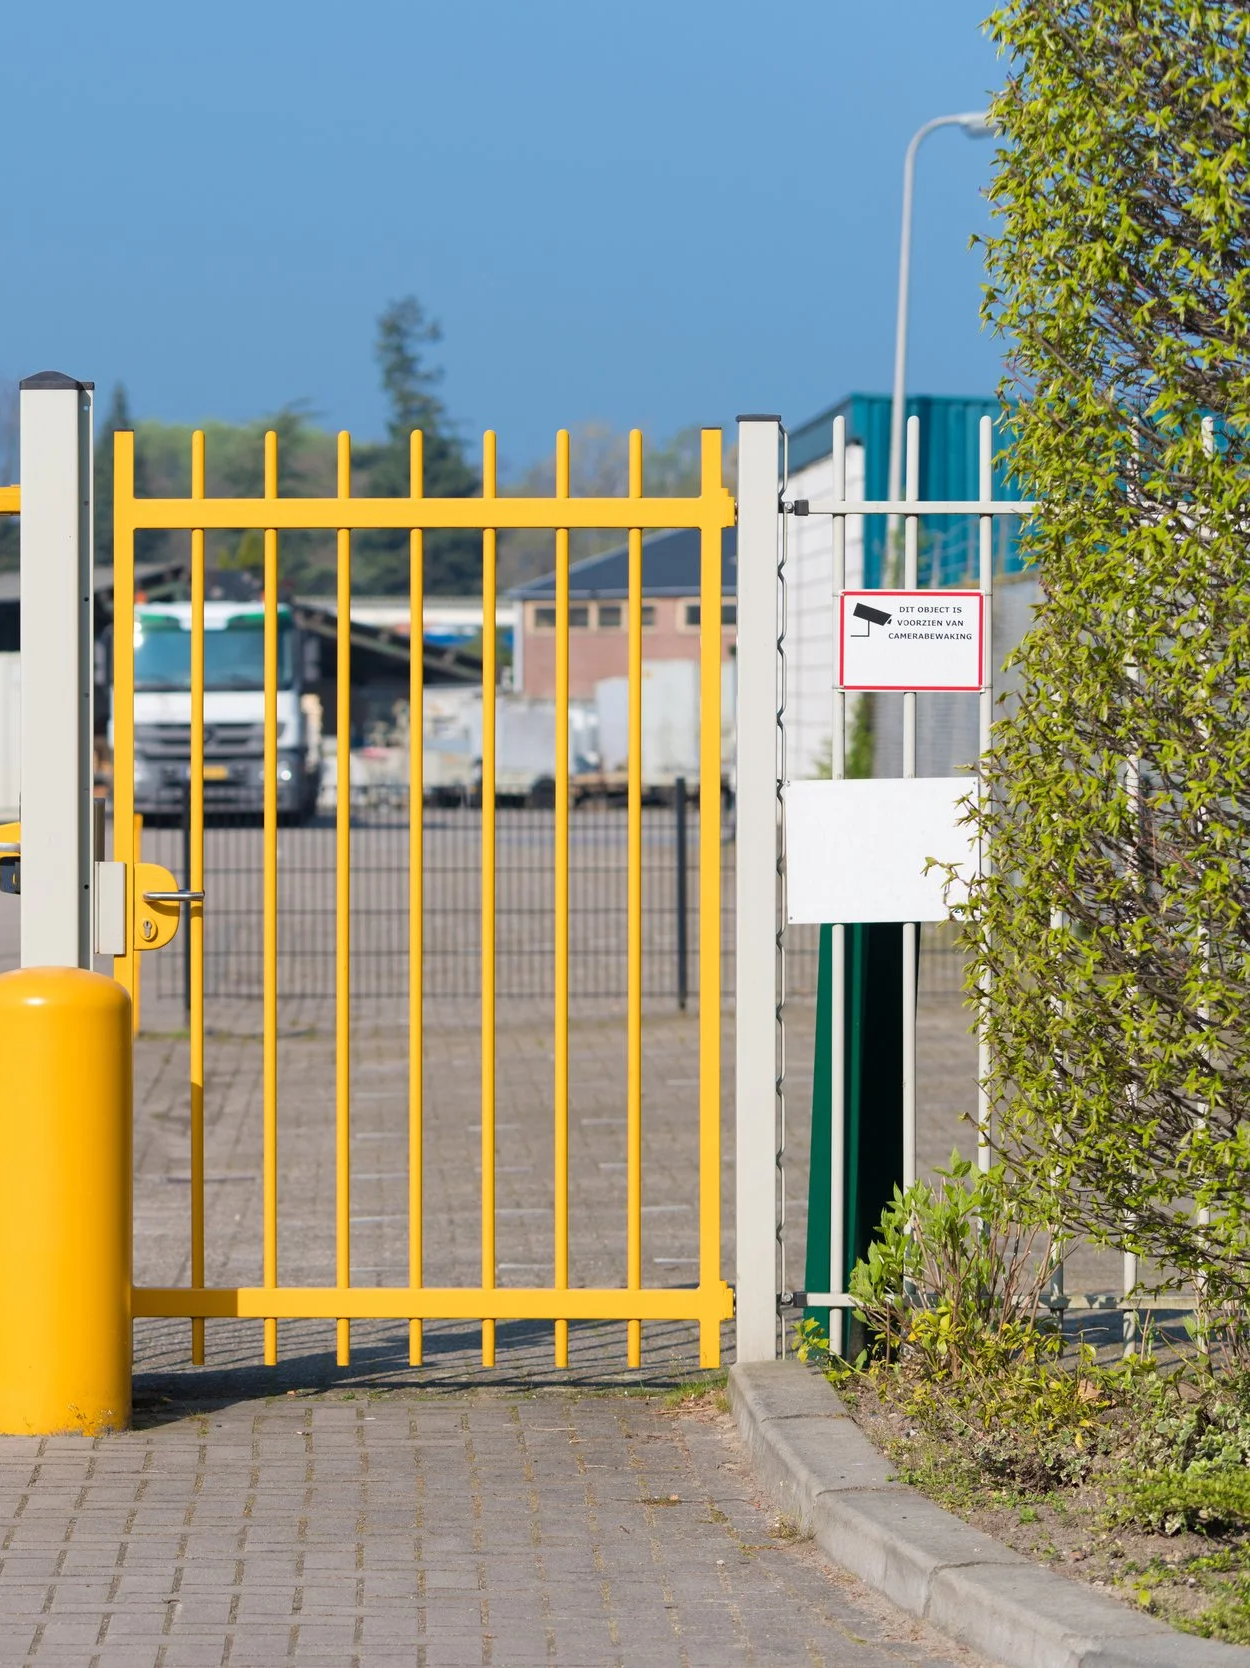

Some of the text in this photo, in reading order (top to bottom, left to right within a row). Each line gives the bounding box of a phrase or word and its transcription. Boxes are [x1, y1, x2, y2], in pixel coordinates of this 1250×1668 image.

[917, 606, 950, 614] OBJECT
[952, 606, 963, 614] IS
[897, 619, 964, 627] VOORZIEN VAN
[888, 632, 972, 640] CAMERABEWAKING
